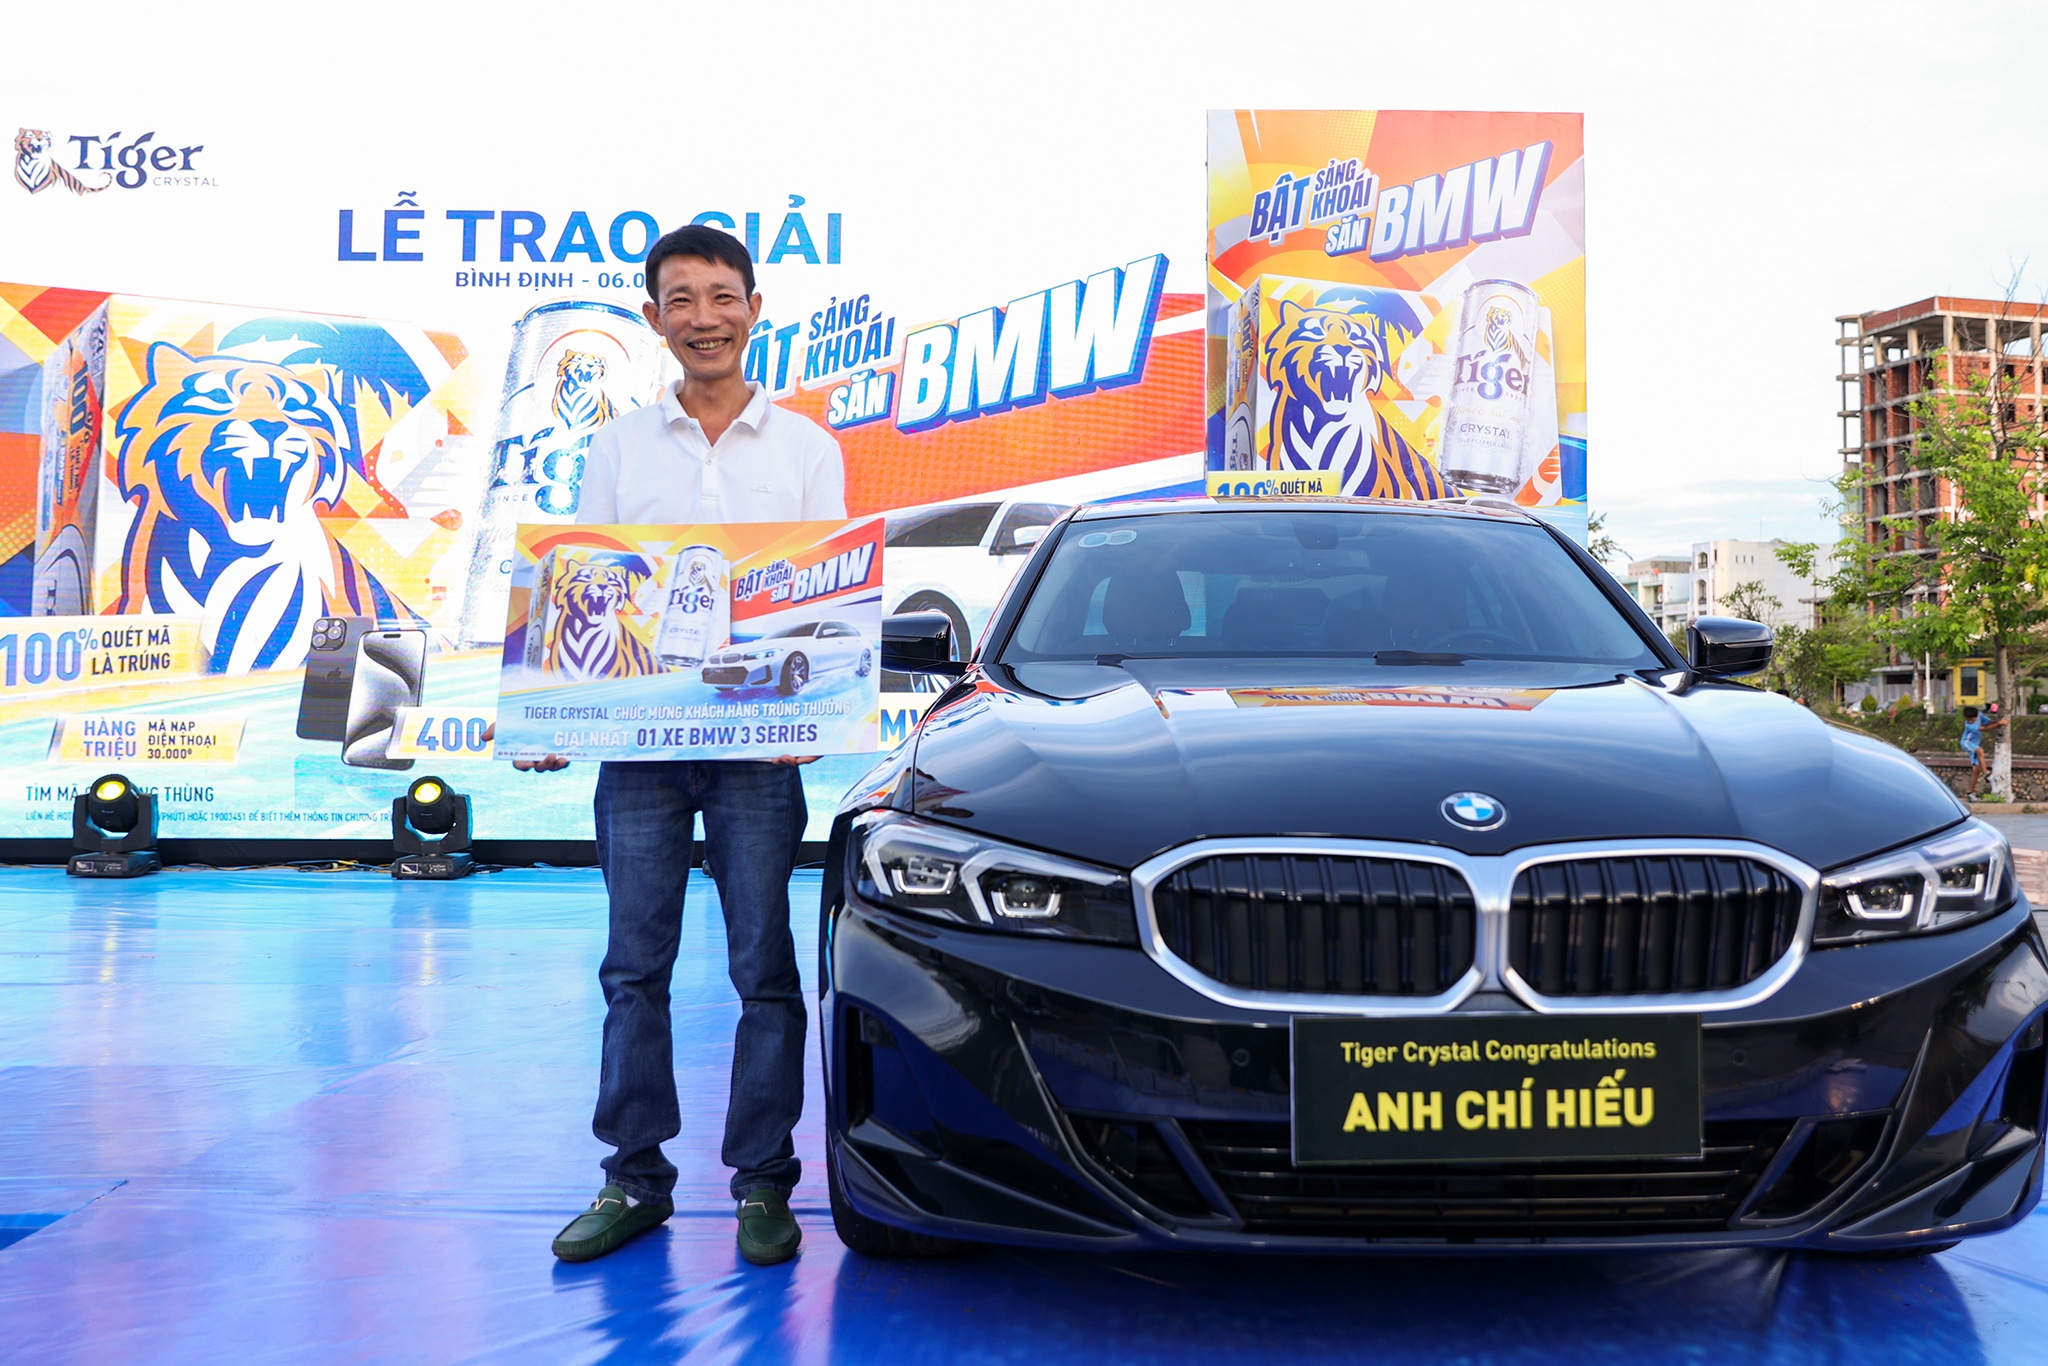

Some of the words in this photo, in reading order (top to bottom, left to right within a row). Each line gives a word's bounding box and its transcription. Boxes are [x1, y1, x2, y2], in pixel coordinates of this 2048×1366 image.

[67, 131, 204, 189] Tiger
[1315, 159, 1357, 192] SẢNG
[153, 176, 219, 187] CRYSTAL
[1310, 172, 1373, 221] KHOÁI
[1249, 173, 1311, 241] BẬT
[1369, 140, 1553, 262] BMW
[338, 190, 425, 262] LỄ
[446, 210, 660, 263] TRAO
[1324, 214, 1371, 257] SĂN
[456, 267, 510, 287] BÌNH
[517, 271, 573, 291] ĐỊNH
[598, 272, 645, 288] 06.0
[808, 293, 870, 341] SẢNG
[744, 319, 801, 391] ẬT
[803, 311, 896, 382] KHOÁI
[896, 253, 1169, 434] BMW
[828, 368, 895, 429] SĂN
[1460, 423, 1512, 440] CRYSTAL
[489, 426, 595, 516] Tig
[1280, 477, 1306, 494] QUÉT
[1308, 477, 1323, 493] MÃ
[736, 569, 763, 600] BẬT
[764, 564, 793, 588] KHOÁI
[792, 541, 876, 603] BMW
[0, 628, 98, 687] 100%
[102, 626, 143, 648] QUÉT
[148, 625, 171, 646] MÃ
[92, 652, 113, 676] LÀ
[118, 650, 171, 672] TRÚNG
[524, 706, 557, 719] TIGER
[560, 706, 609, 720] CRYSTAL
[614, 704, 646, 720] CHÚC
[649, 703, 683, 720] MỪNG
[685, 703, 724, 719] KHÁCH
[726, 701, 759, 718] HÀNG
[762, 699, 800, 717] TRÚNG
[803, 698, 851, 716] THƯỞNG
[84, 716, 136, 736] HÀNG
[148, 719, 165, 731] MÃ
[170, 721, 195, 734] NẠP
[148, 733, 176, 748] ĐIỆN
[181, 734, 216, 748] THOẠI
[416, 717, 487, 752] 400
[554, 727, 585, 747] GIẢI
[589, 727, 630, 747] NHẤT
[637, 728, 656, 746] 01
[662, 728, 684, 746] XE
[689, 726, 736, 746] BMW
[741, 726, 750, 744] 3
[755, 724, 818, 743] SERIES
[83, 737, 136, 760] TRIỆU
[58, 783, 78, 801] MÃ
[164, 783, 214, 802] THÙNG
[331, 812, 343, 821] TIN
[1340, 1041, 1398, 1067] Tiger
[1403, 1040, 1480, 1066] Crystal
[1485, 1037, 1657, 1065] Congratulations
[1342, 1091, 1443, 1132] ANH
[1455, 1077, 1535, 1130] CHÍ
[1546, 1068, 1654, 1129] HIẾU
